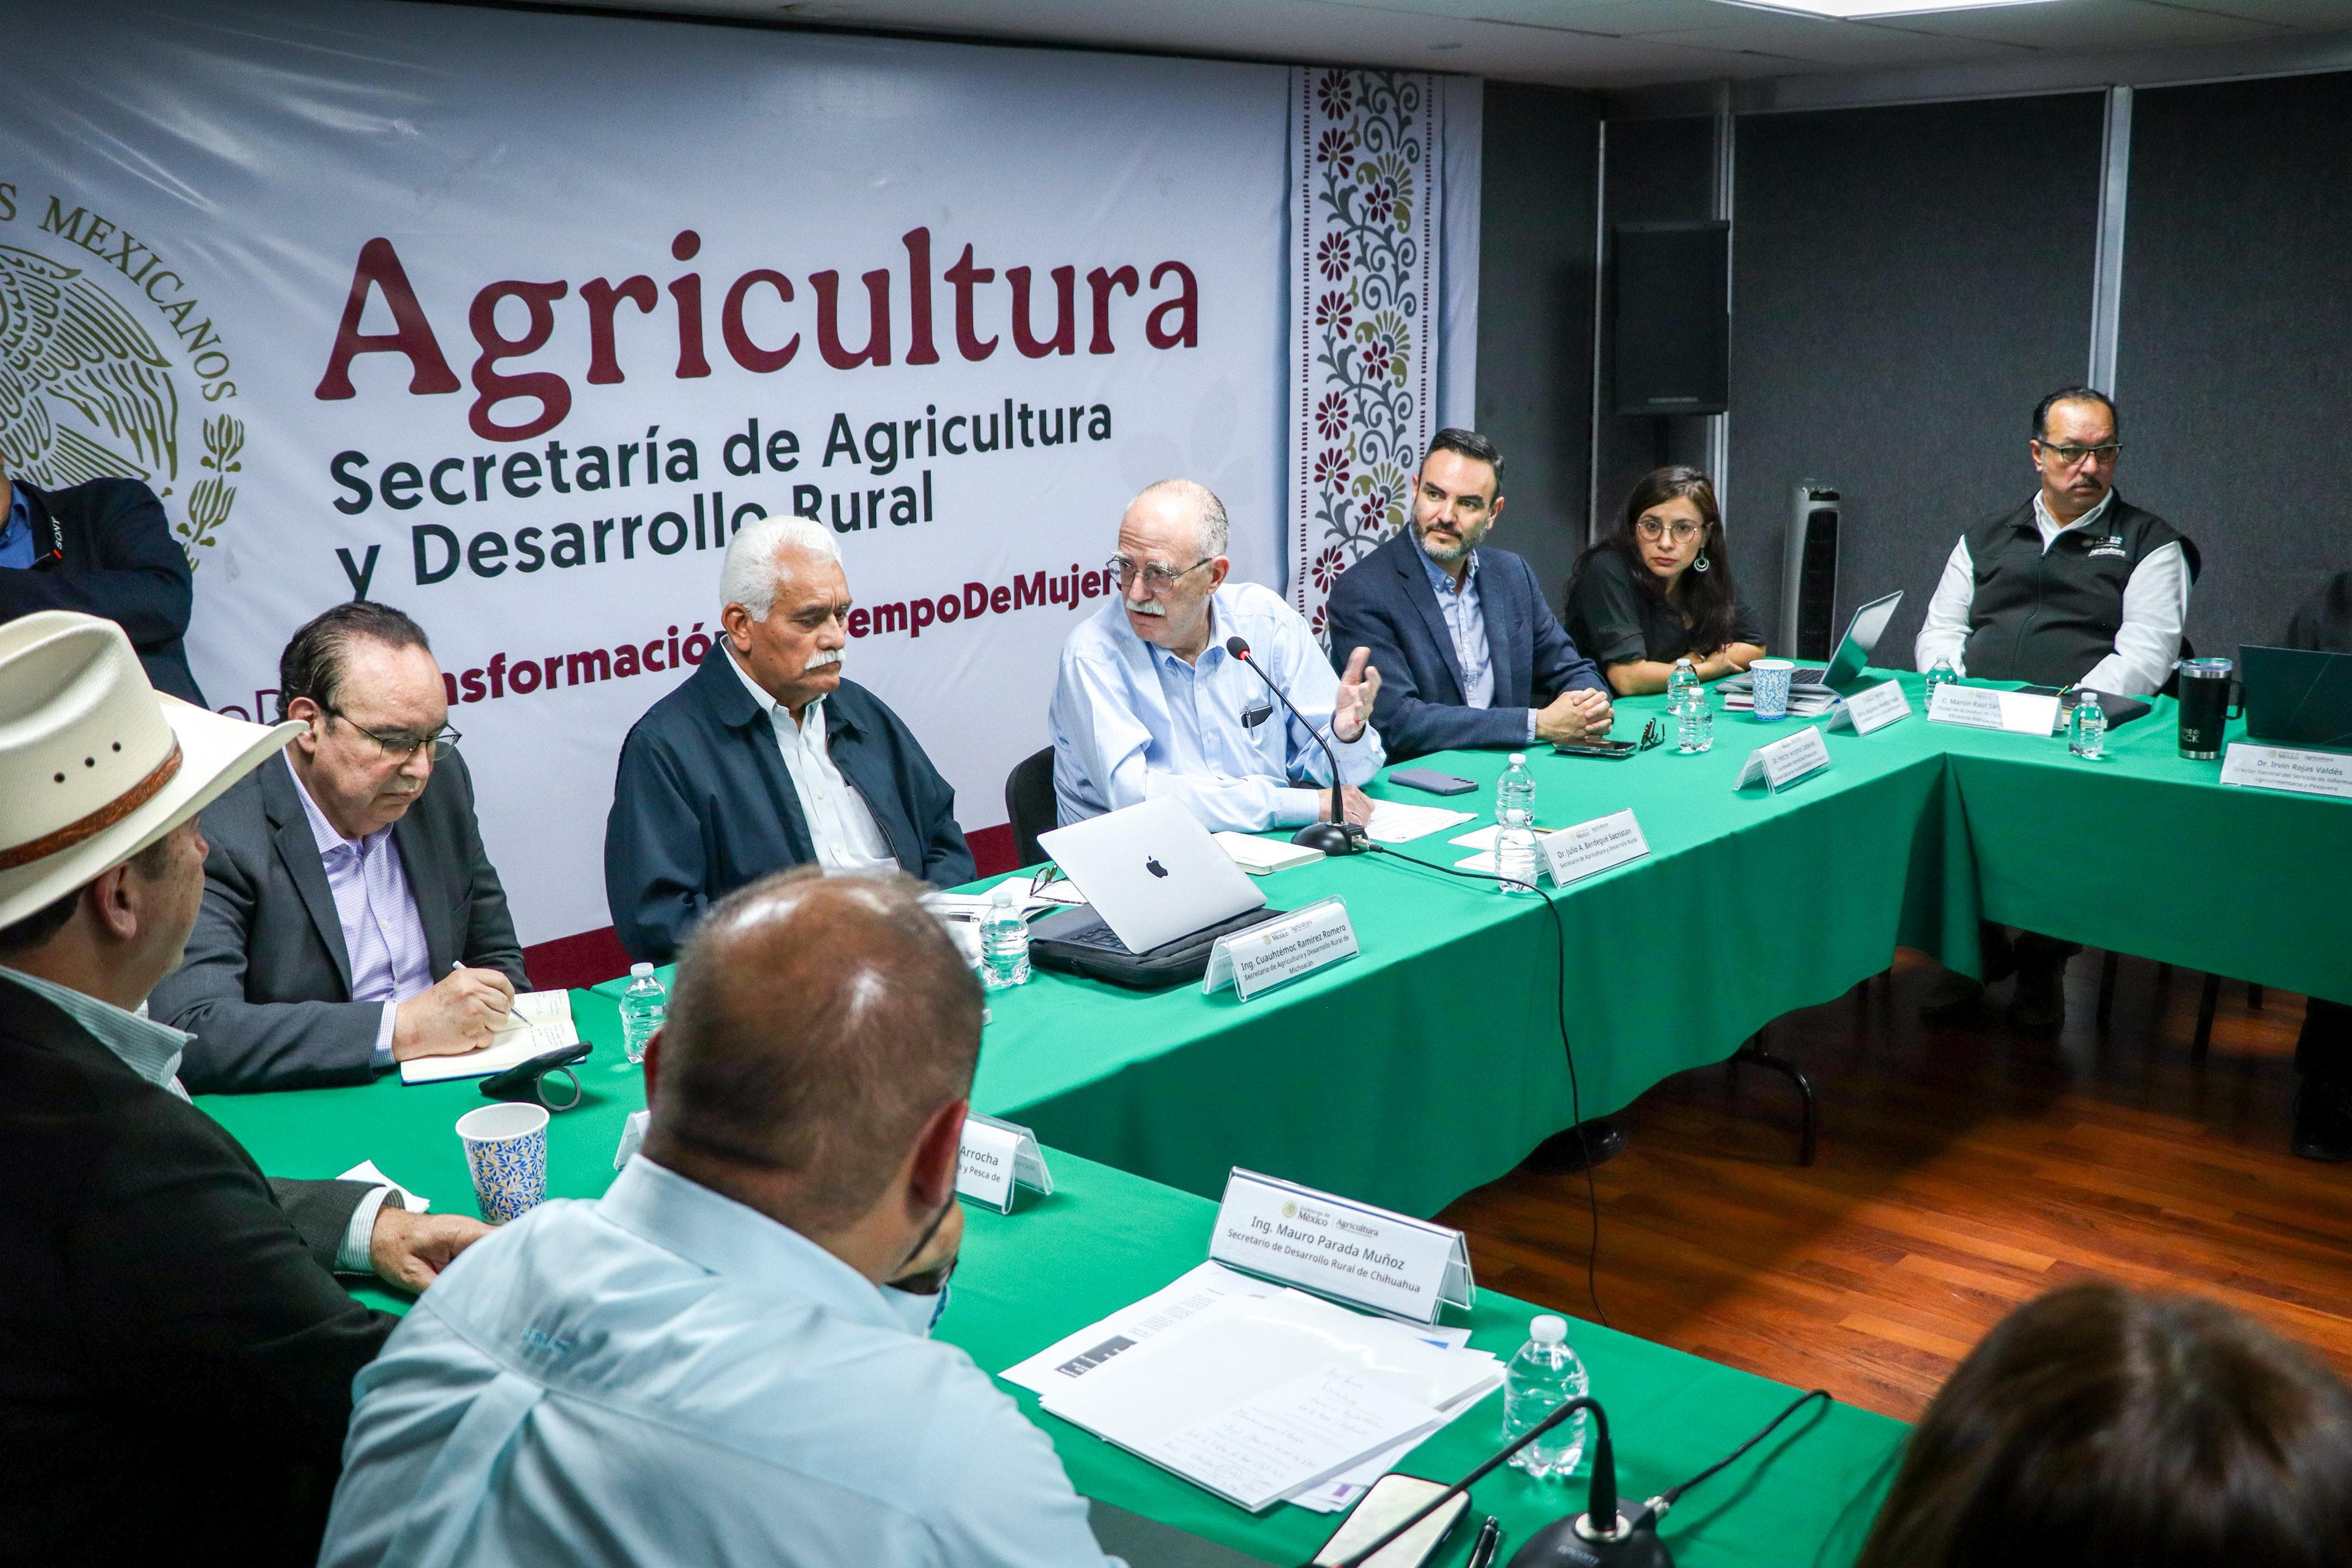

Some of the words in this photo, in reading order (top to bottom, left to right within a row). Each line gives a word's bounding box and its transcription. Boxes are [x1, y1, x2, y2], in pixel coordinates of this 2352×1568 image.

[38, 196, 237, 402] MEXICANOS
[314, 226, 1198, 443] Agricultura
[330, 425, 698, 515] Secretaría
[723, 418, 799, 477] de
[822, 399, 1112, 475] Agricultura
[51, 516, 62, 550] SONY
[335, 544, 381, 601] y
[793, 470, 933, 533] Rural
[447, 621, 725, 706] nsformació
[849, 563, 1122, 639] empoDeMujer
[1950, 698, 1971, 707] Martín
[2271, 761, 2290, 769] Irvin
[2292, 764, 2314, 774] Rojas
[2316, 765, 2343, 776] Valdés
[1557, 850, 1567, 859] Dr.
[1567, 847, 1578, 858] Julio
[1584, 836, 1609, 849] Berdegué
[1609, 828, 1632, 841] Sacristán
[1559, 858, 1580, 868] Secretario
[1585, 849, 1606, 860] Agricultura
[1609, 842, 1627, 852] Desarrollo
[1627, 837, 1637, 846] Rural
[1240, 960, 1256, 971] Ing.
[1256, 943, 1296, 965] Cuauhtémoc
[1297, 934, 1322, 949] Ramírez
[1322, 924, 1346, 938] Romero
[1271, 931, 1289, 942] México
[1290, 919, 1313, 932] Agricultura
[1244, 967, 1270, 981] Secretario
[1277, 954, 1303, 969] Agricultura
[1307, 943, 1330, 958] Desarrollo
[1330, 937, 1342, 948] Rural
[1289, 960, 1314, 975] Michoacán
[960, 1146, 998, 1166] Arrocha
[970, 1166, 989, 1179] Pesca
[991, 1173, 1001, 1183] de
[1297, 1211, 1328, 1227] México
[1336, 1218, 1379, 1237] Agricultura
[1251, 1216, 1273, 1235] Ing.
[1277, 1223, 1315, 1245] Mauro
[1317, 1235, 1359, 1258] Parada
[1363, 1248, 1405, 1271] Muñoz
[1227, 1228, 1270, 1249] Secretario
[1271, 1240, 1282, 1252] de
[1284, 1245, 1329, 1266] Desarrollo
[1331, 1258, 1355, 1275] Rural
[1357, 1265, 1368, 1277] de
[1370, 1270, 1420, 1294] Chihuahua
